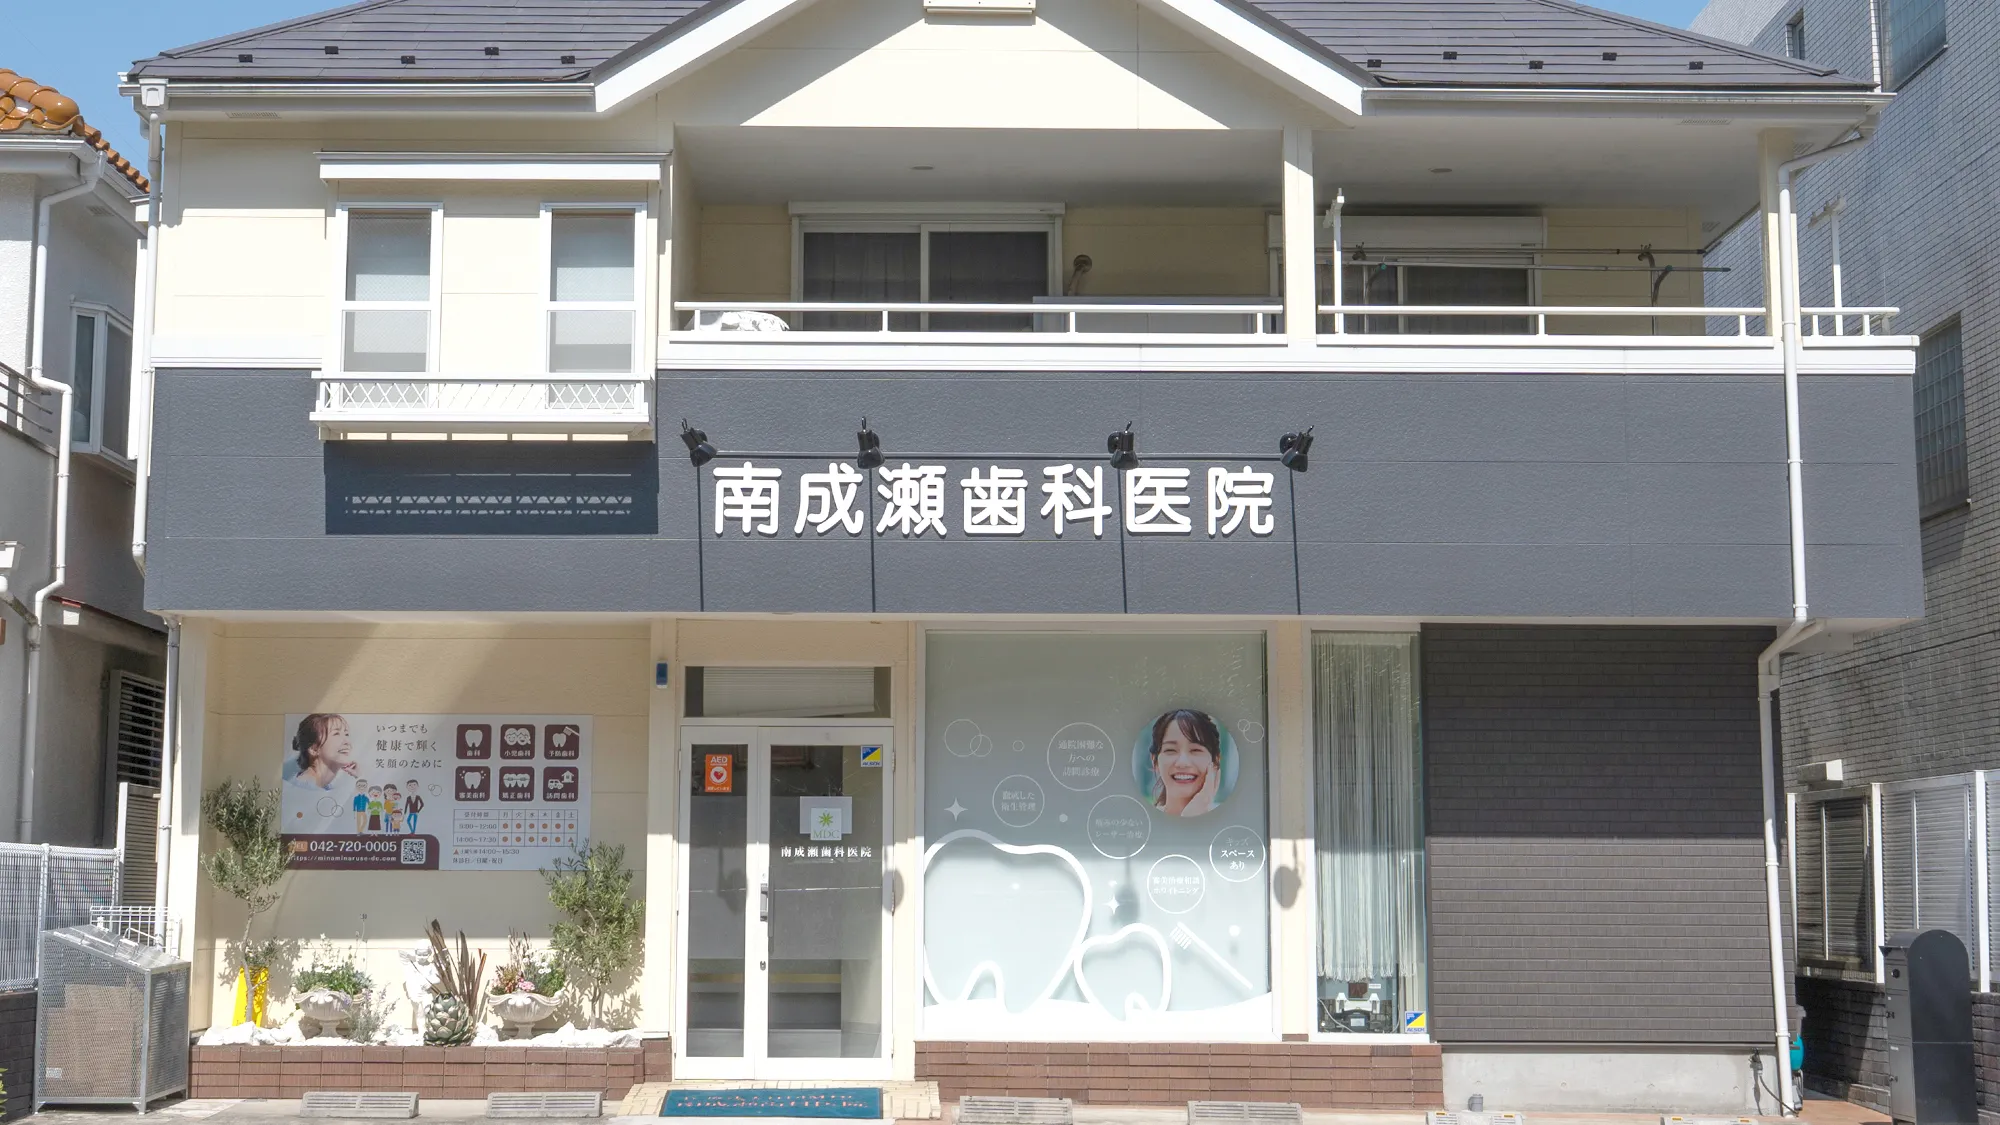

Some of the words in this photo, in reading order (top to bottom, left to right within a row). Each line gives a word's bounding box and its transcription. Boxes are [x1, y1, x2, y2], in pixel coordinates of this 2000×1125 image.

[713, 461, 1275, 536] 南成瀬歯科医院
[376, 724, 428, 734] いつまでも
[376, 740, 437, 752] 健康で輝く
[1068, 753, 1095, 763] 方への
[375, 758, 442, 769] 笑顔のために
[813, 830, 840, 839] MDC
[310, 840, 397, 852] 042-720-0005
[1225, 837, 1249, 847] キッズ
[781, 846, 872, 858] 南成瀬歯科医院
[1220, 850, 1255, 858] スペース
[1229, 861, 1245, 871] あり
[1153, 887, 1199, 895] ホワイトニング
